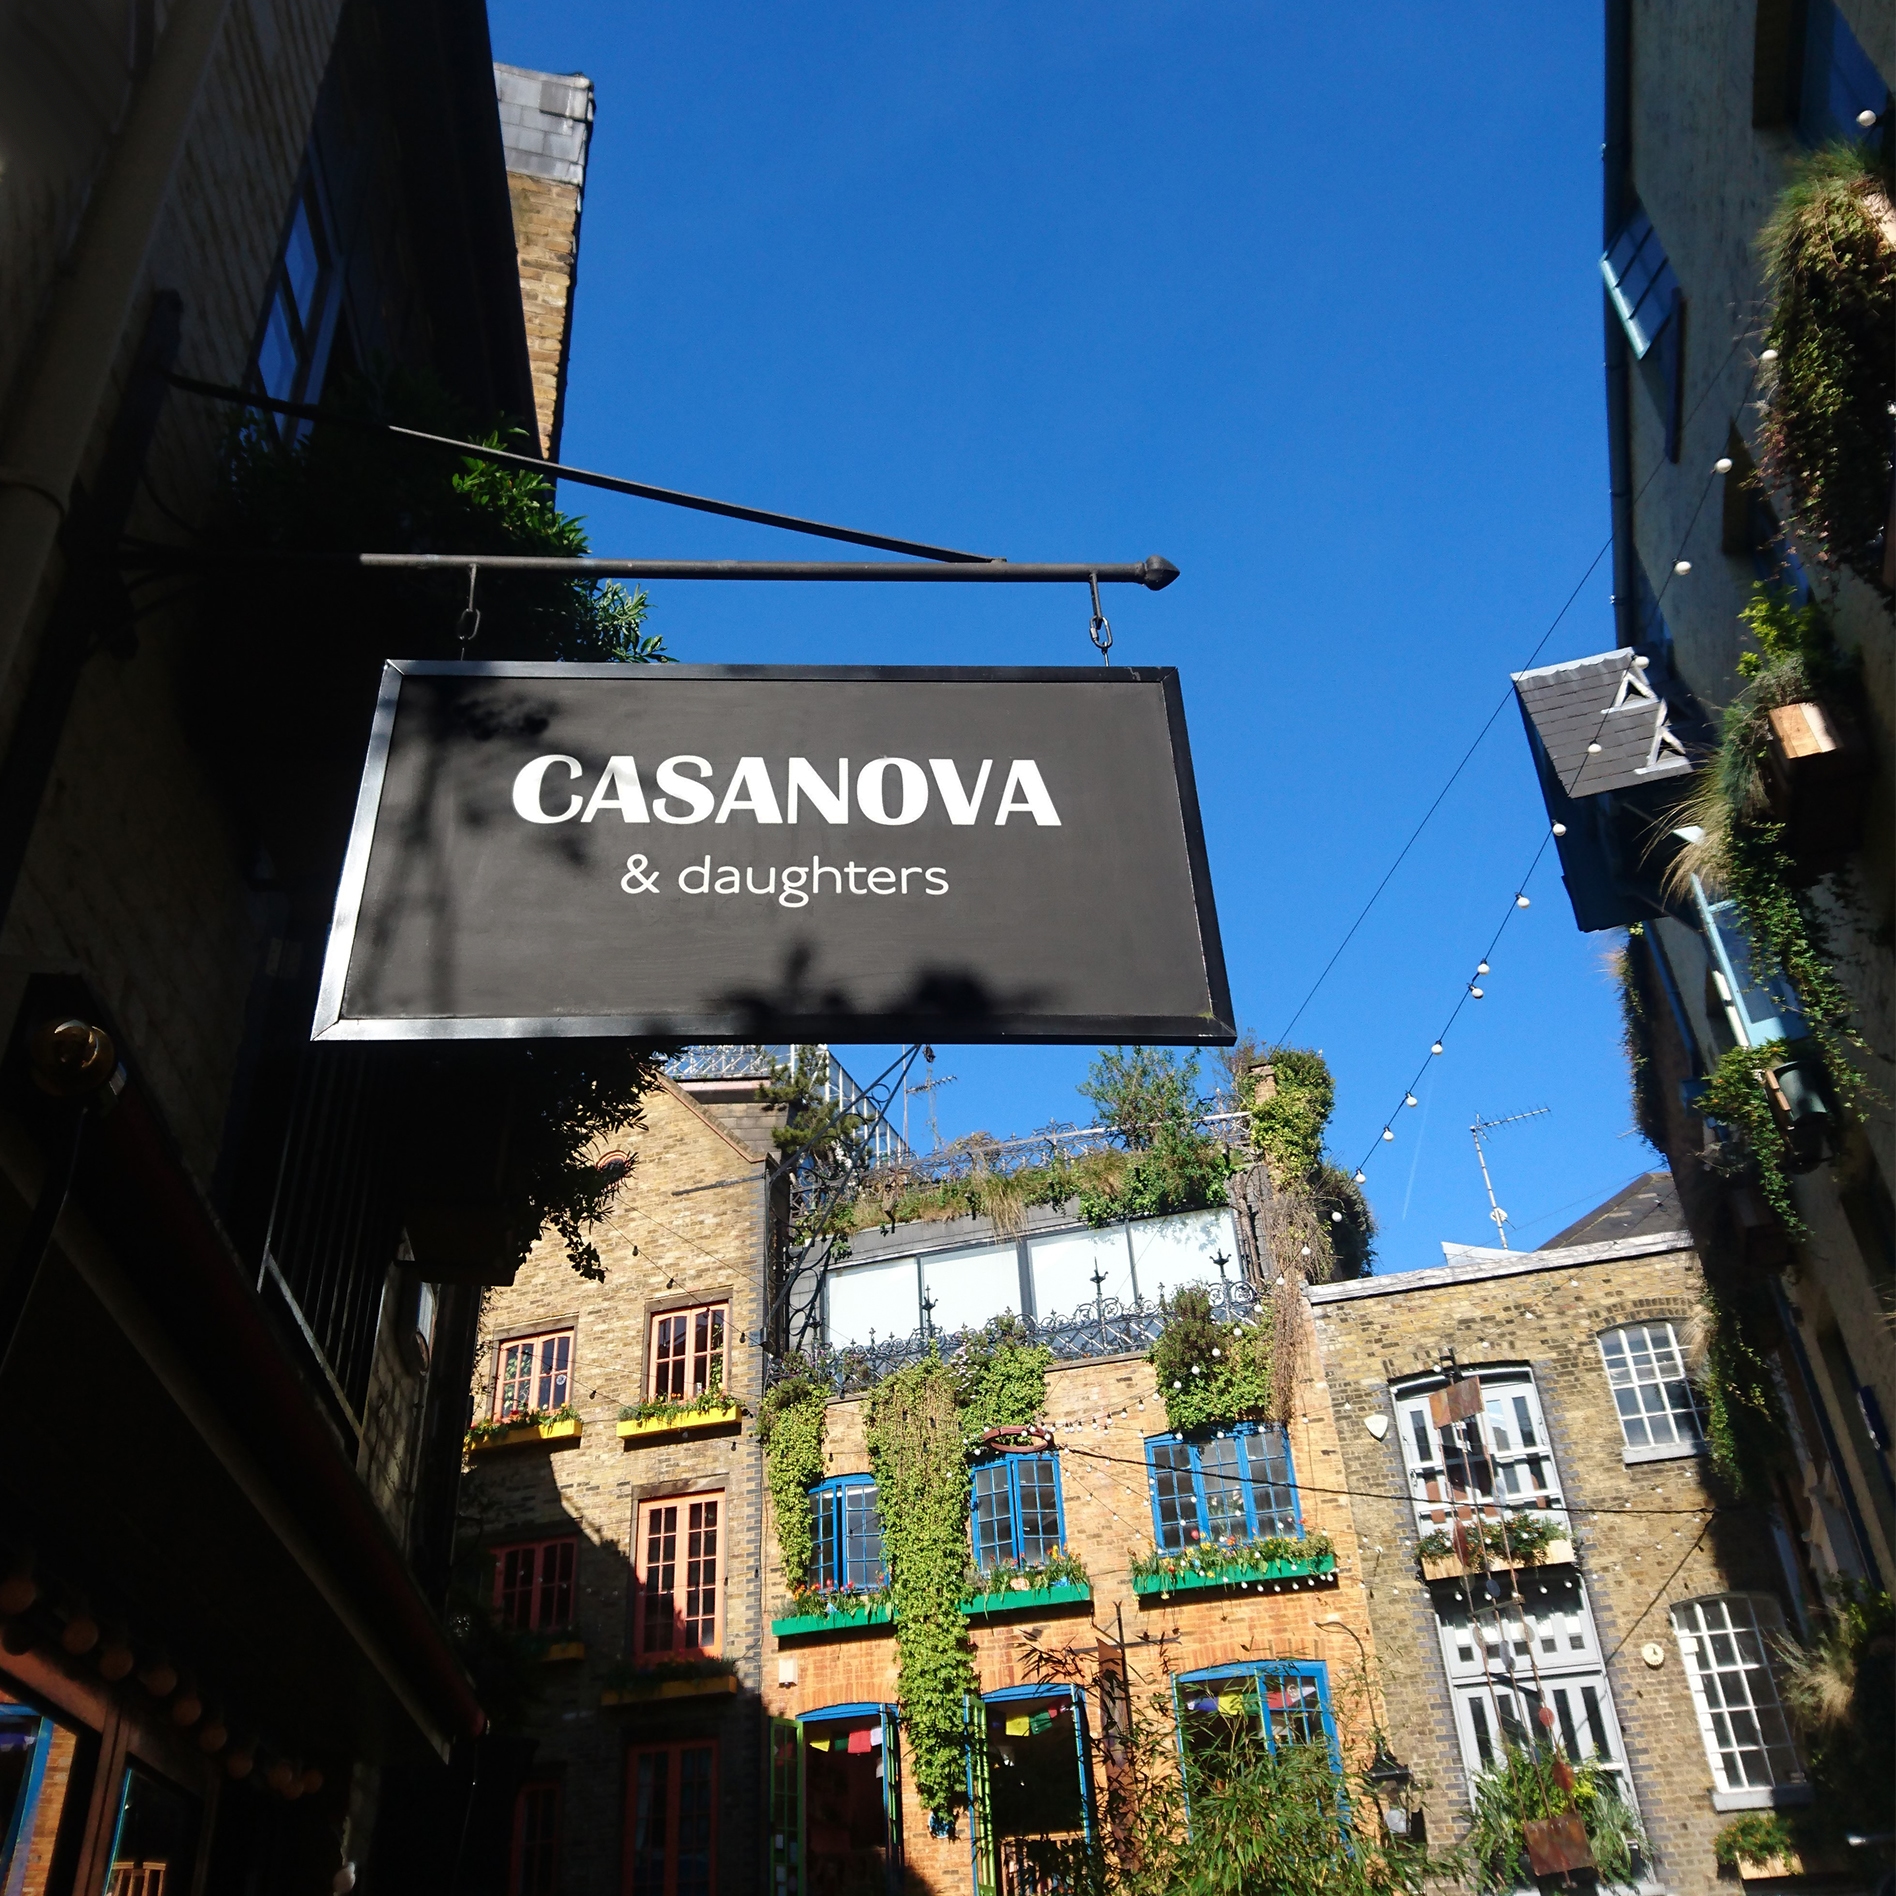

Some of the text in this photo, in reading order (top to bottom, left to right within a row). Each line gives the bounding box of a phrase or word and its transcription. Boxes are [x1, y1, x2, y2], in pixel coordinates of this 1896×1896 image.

[512, 754, 1062, 826] CASANOVA
[620, 853, 950, 908] & daughters
